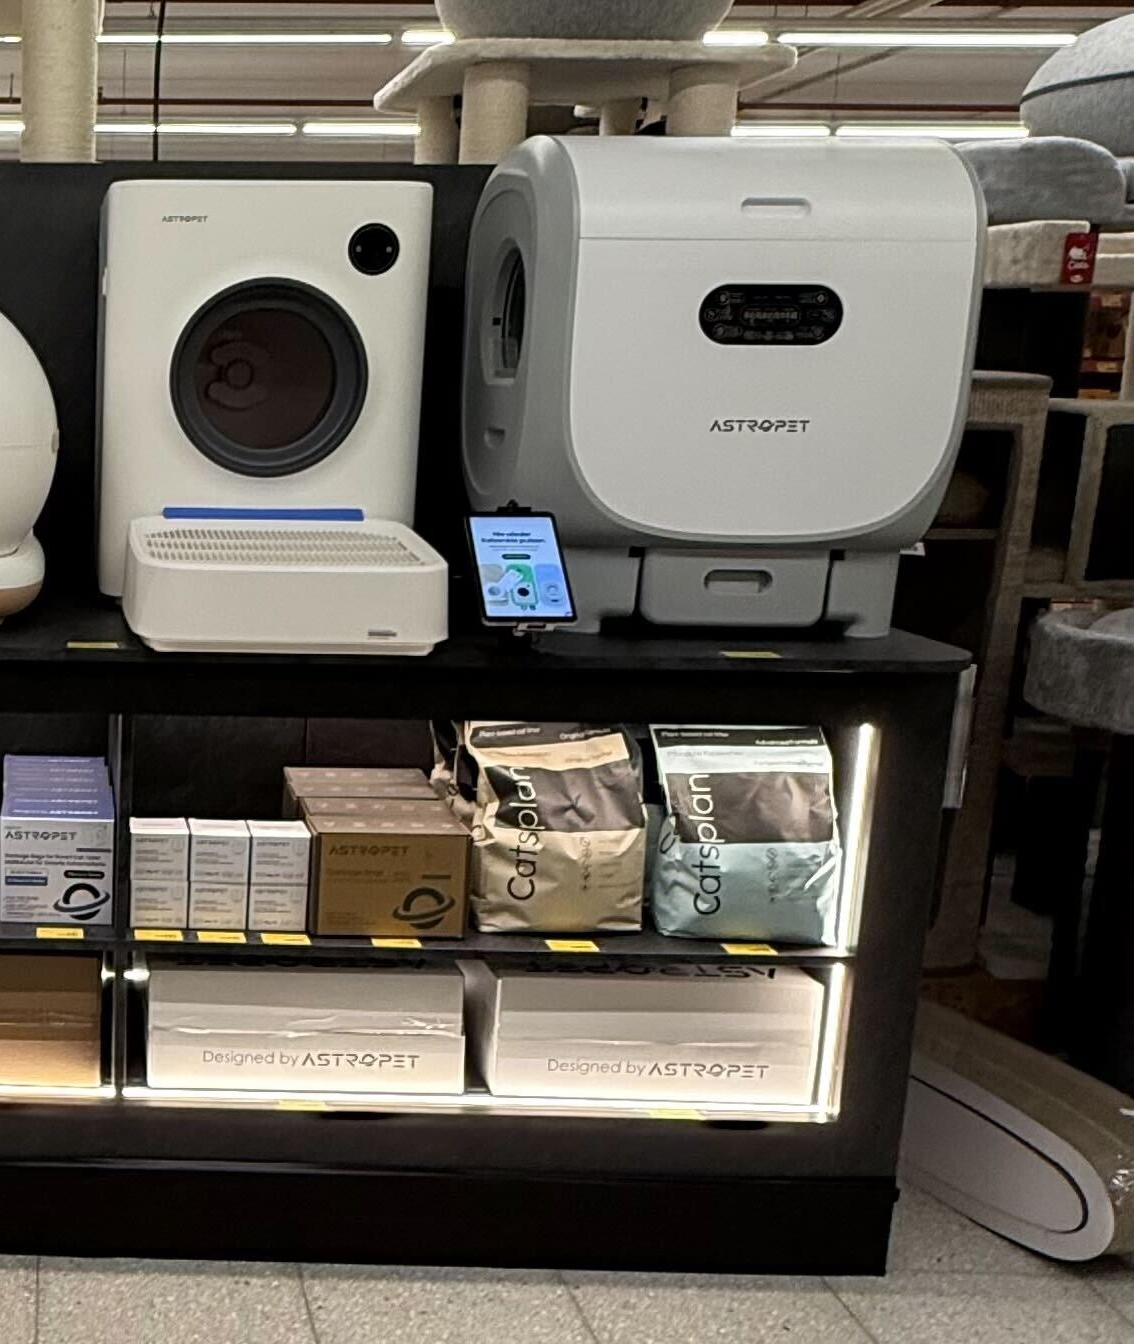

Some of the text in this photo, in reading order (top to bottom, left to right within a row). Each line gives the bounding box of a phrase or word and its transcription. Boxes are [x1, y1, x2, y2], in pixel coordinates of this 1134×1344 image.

[709, 419, 811, 433] ASTROPET
[4, 831, 77, 841] ASTROPET
[507, 767, 546, 900] Catsplan
[329, 845, 410, 856] ASTROPET
[688, 773, 725, 916] Catsplan
[202, 1050, 420, 1068] Designed by ASTROPET
[547, 1058, 770, 1079] Designed by ASTROPET
